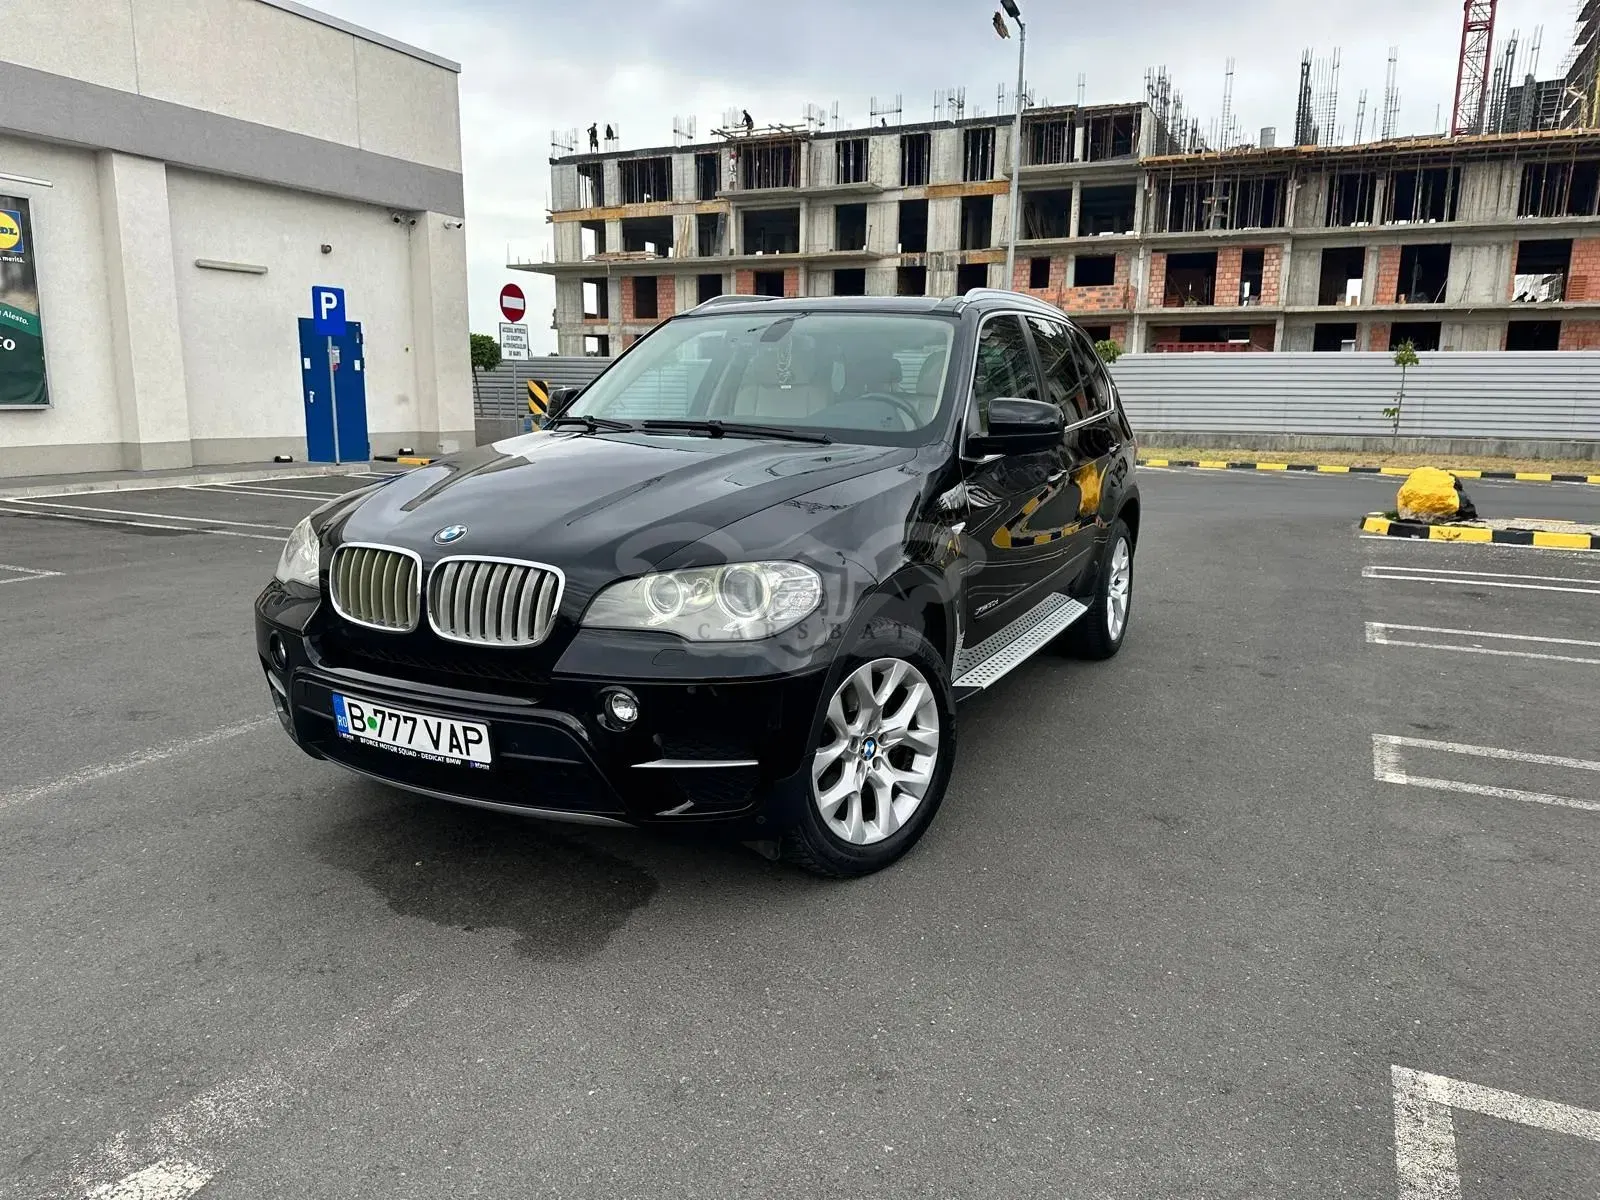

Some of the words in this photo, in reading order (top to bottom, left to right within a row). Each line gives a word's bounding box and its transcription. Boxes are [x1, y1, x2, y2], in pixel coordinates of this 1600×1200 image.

[2, 310, 29, 325] Alesto.
[320, 291, 338, 320] P
[337, 715, 348, 728] RO
[347, 702, 367, 733] B
[373, 708, 418, 745] 777
[423, 719, 484, 757] VAP
[379, 742, 398, 753] MOTOR
[398, 747, 417, 757] SQUAD
[421, 753, 445, 763] DEDICAT
[445, 757, 462, 766] BMW
